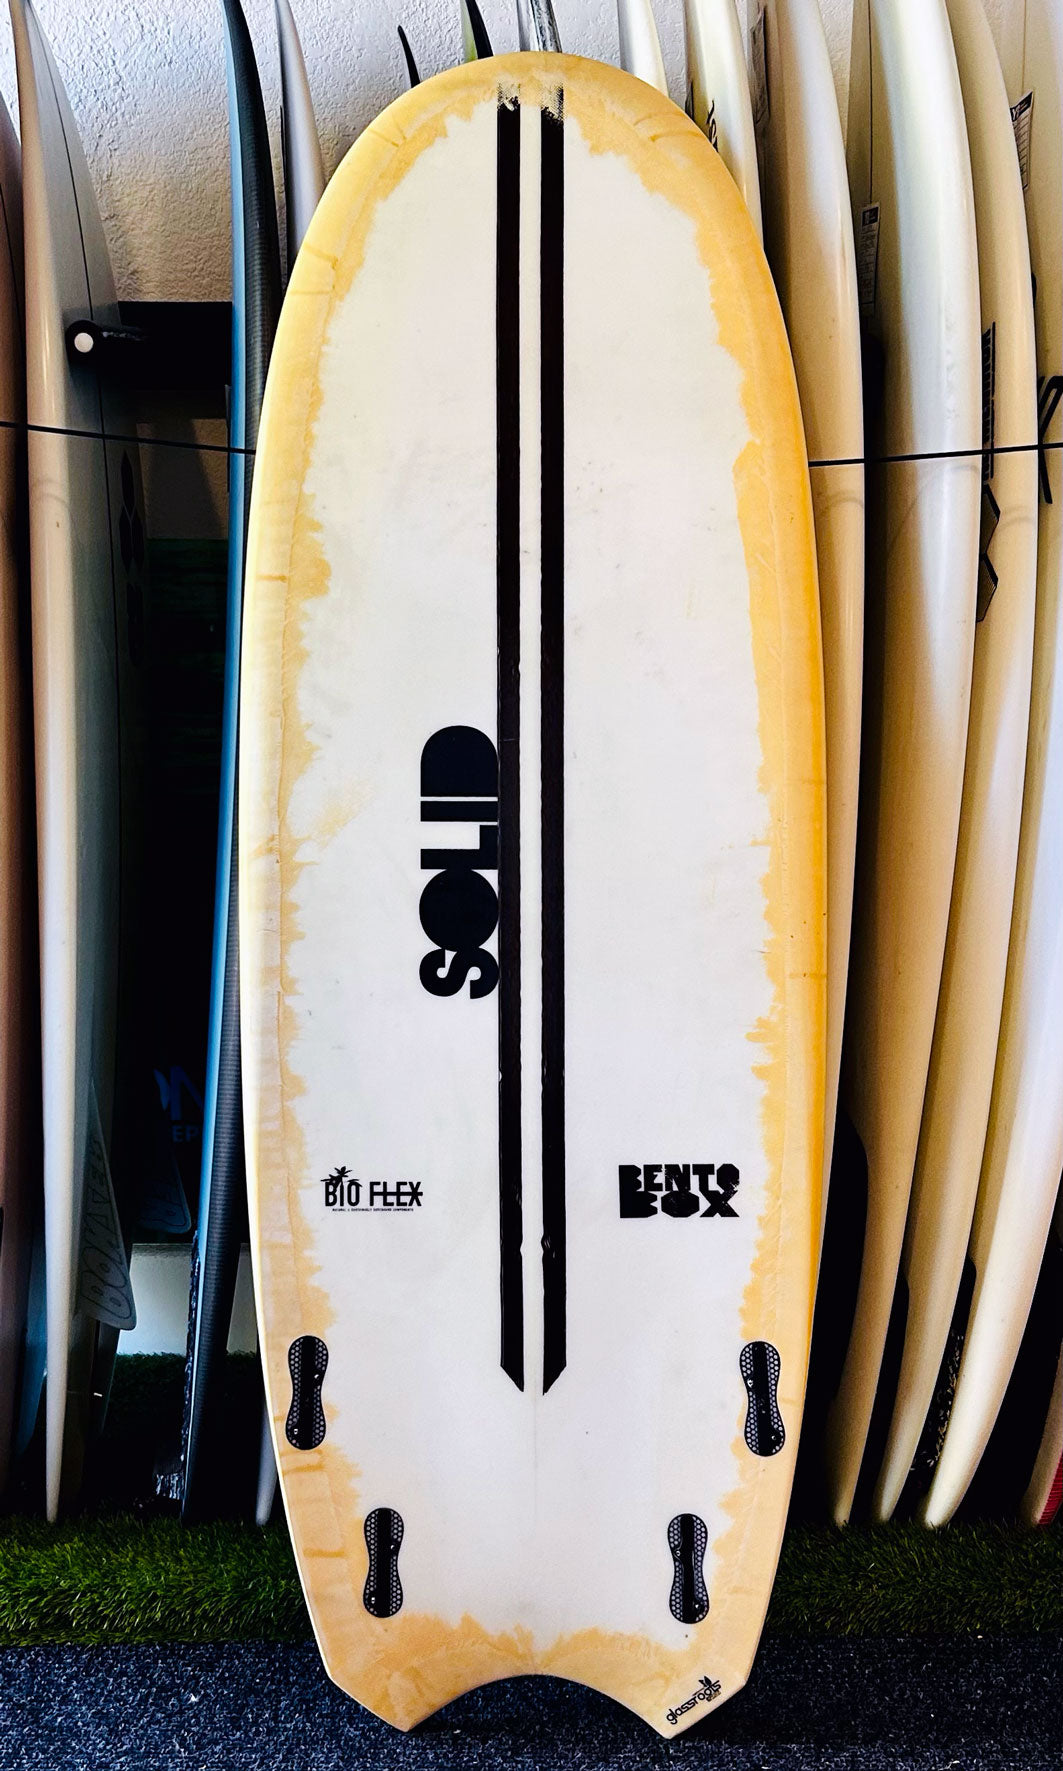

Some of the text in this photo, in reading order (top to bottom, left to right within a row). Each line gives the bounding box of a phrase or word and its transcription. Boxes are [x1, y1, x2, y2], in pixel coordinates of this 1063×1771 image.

[419, 725, 500, 1000] SOLID
[618, 1163, 740, 1192] BENTO
[324, 1180, 423, 1207] BIO FLEX
[619, 1190, 740, 1218] BOX
[666, 1680, 722, 1725] glassroots
